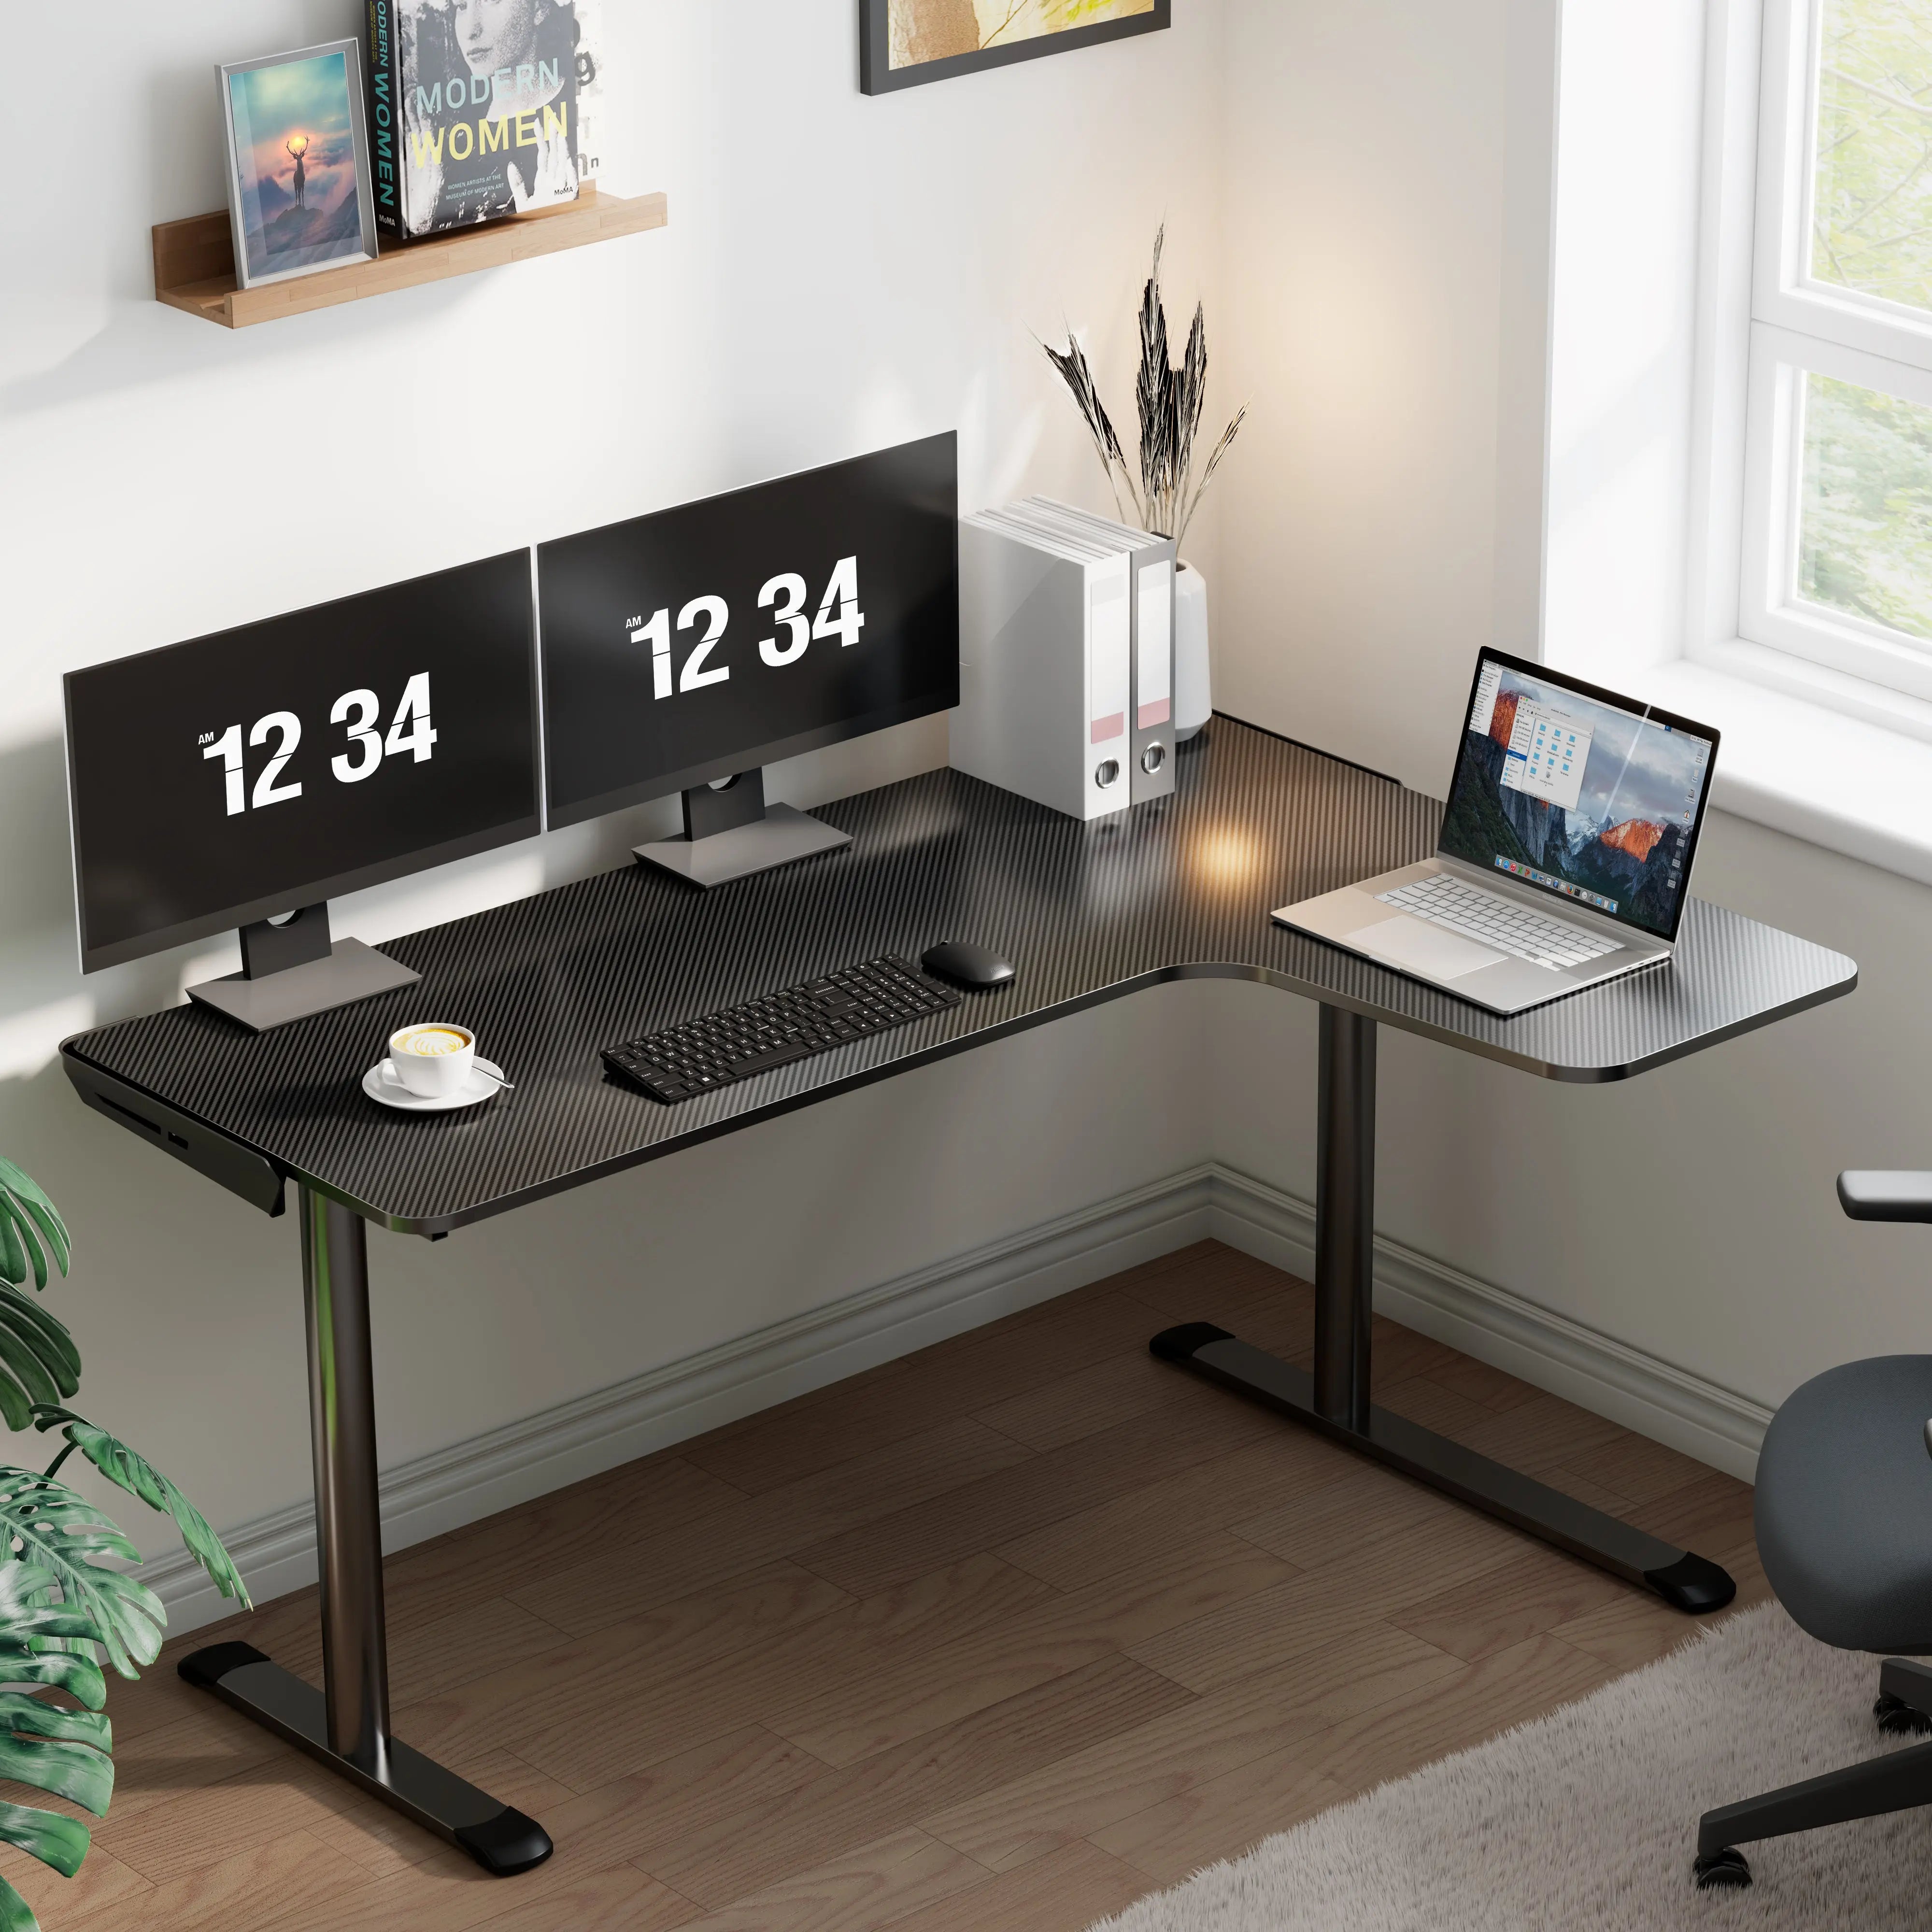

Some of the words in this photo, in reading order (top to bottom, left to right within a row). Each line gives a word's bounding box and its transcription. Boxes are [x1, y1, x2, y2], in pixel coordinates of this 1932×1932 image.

[377, 0, 388, 67] ODERN
[416, 57, 559, 115] MODERN
[374, 72, 394, 206] WOMEN
[411, 101, 568, 169] WOMEN
[446, 191, 467, 200] MUSEUM
[474, 185, 495, 194] MODERN
[466, 177, 485, 186] ARTISTS
[554, 186, 573, 196] MoMA
[379, 214, 396, 227] MoMA
[626, 615, 642, 628] AM
[631, 595, 730, 700] 12
[757, 555, 865, 667] 34
[198, 732, 214, 745] AM
[203, 711, 302, 816] 12
[330, 671, 438, 783] 34
